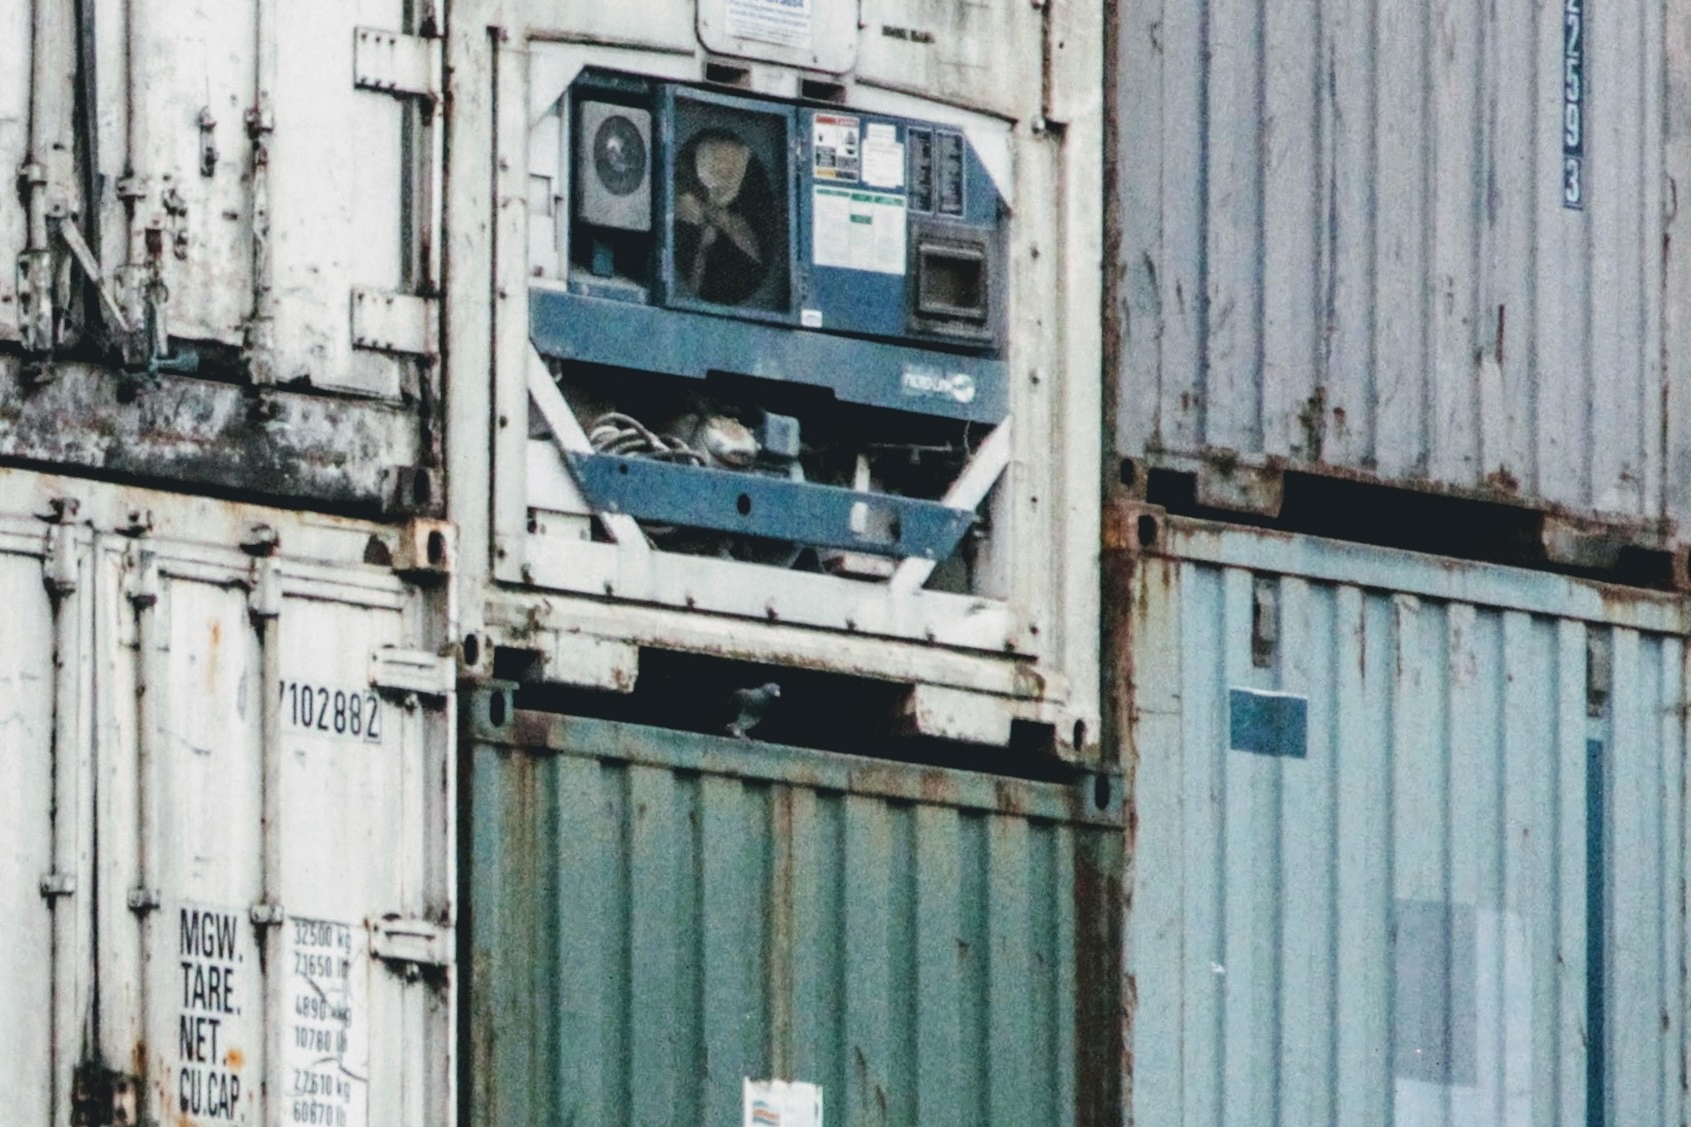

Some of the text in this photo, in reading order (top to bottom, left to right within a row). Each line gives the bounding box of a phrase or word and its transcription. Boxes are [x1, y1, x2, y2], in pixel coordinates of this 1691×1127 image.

[1565, 0, 1580, 147] 259
[180, 908, 243, 963] MGW.
[294, 921, 333, 948] 32500
[180, 962, 241, 1015] TARE.
[295, 995, 327, 1022] 4890
[180, 1015, 227, 1066] NET.
[294, 1025, 332, 1054] 10780
